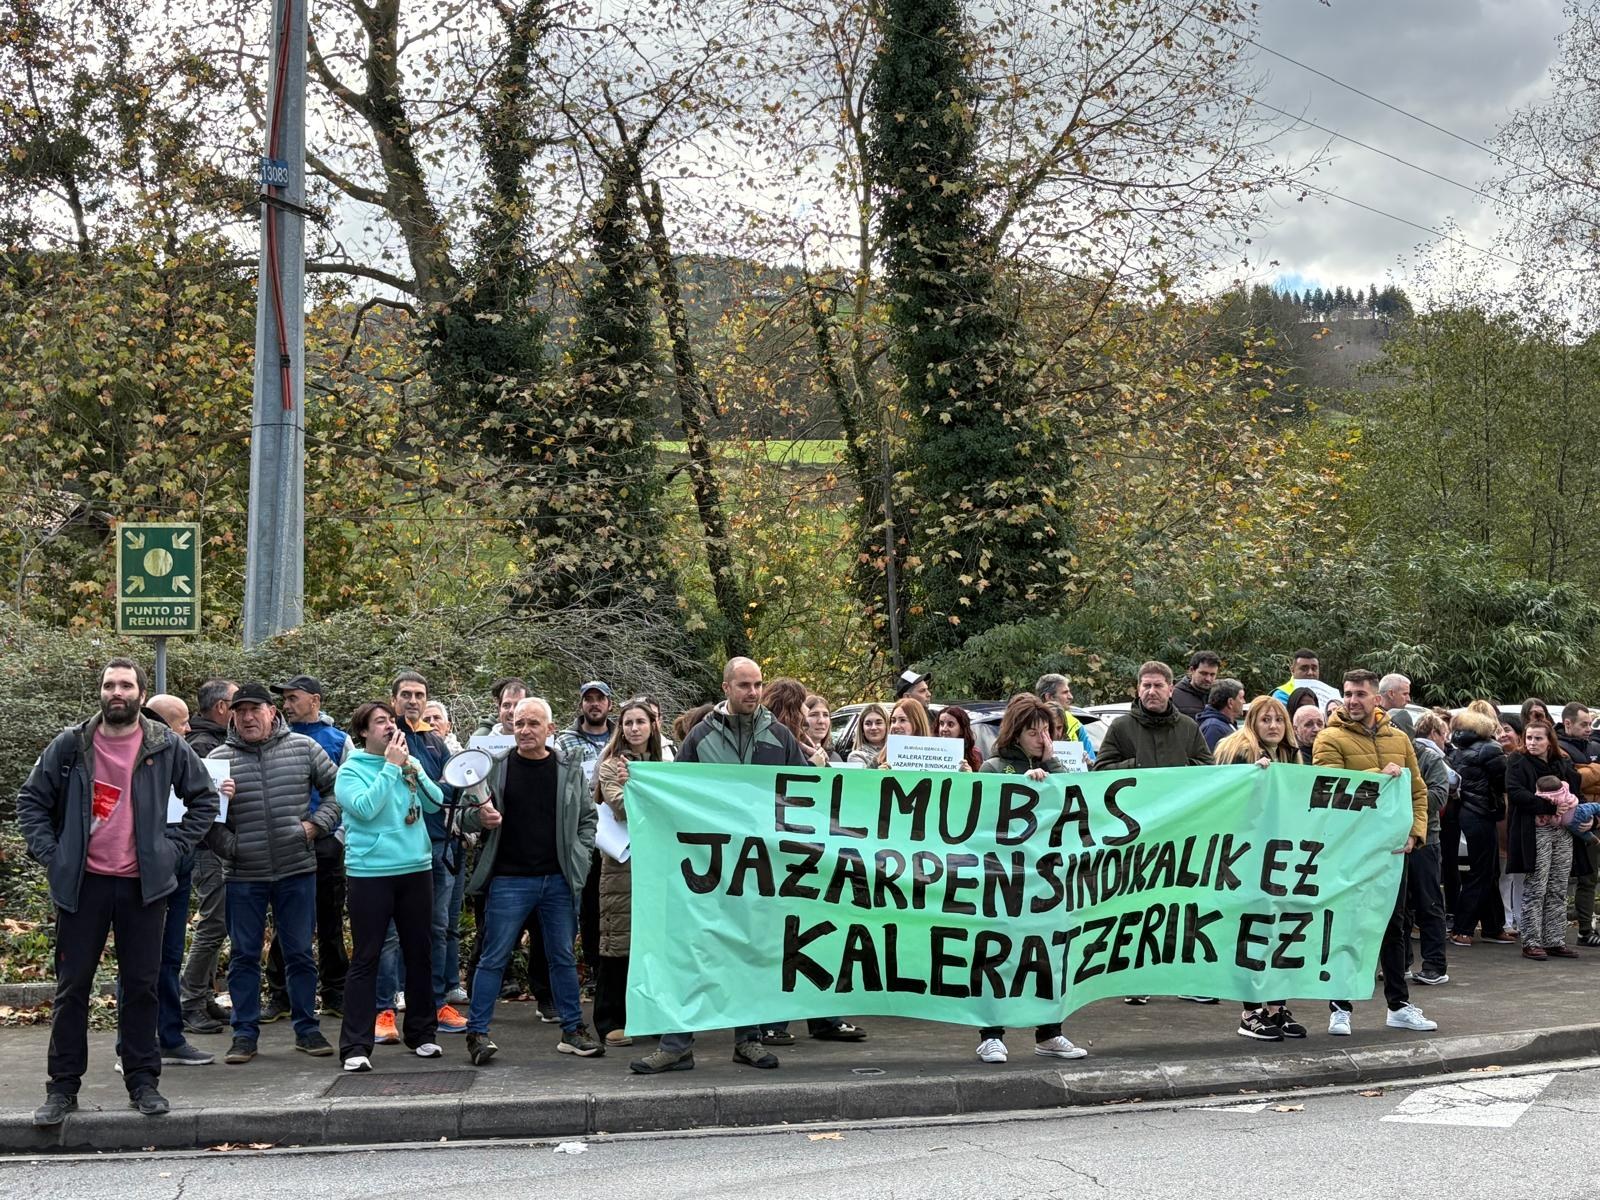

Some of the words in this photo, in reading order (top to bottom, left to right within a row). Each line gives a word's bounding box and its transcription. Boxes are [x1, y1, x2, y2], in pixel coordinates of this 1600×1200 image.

[261, 166, 289, 183] 13083
[125, 606, 170, 616] PUNTO
[174, 606, 191, 616] DE
[129, 617, 188, 626] REUNION
[775, 773, 1140, 848] ELMUBAS
[1309, 775, 1380, 811] ELA
[1260, 839, 1325, 897] EZ
[781, 903, 1224, 1001] KALERATZERIK
